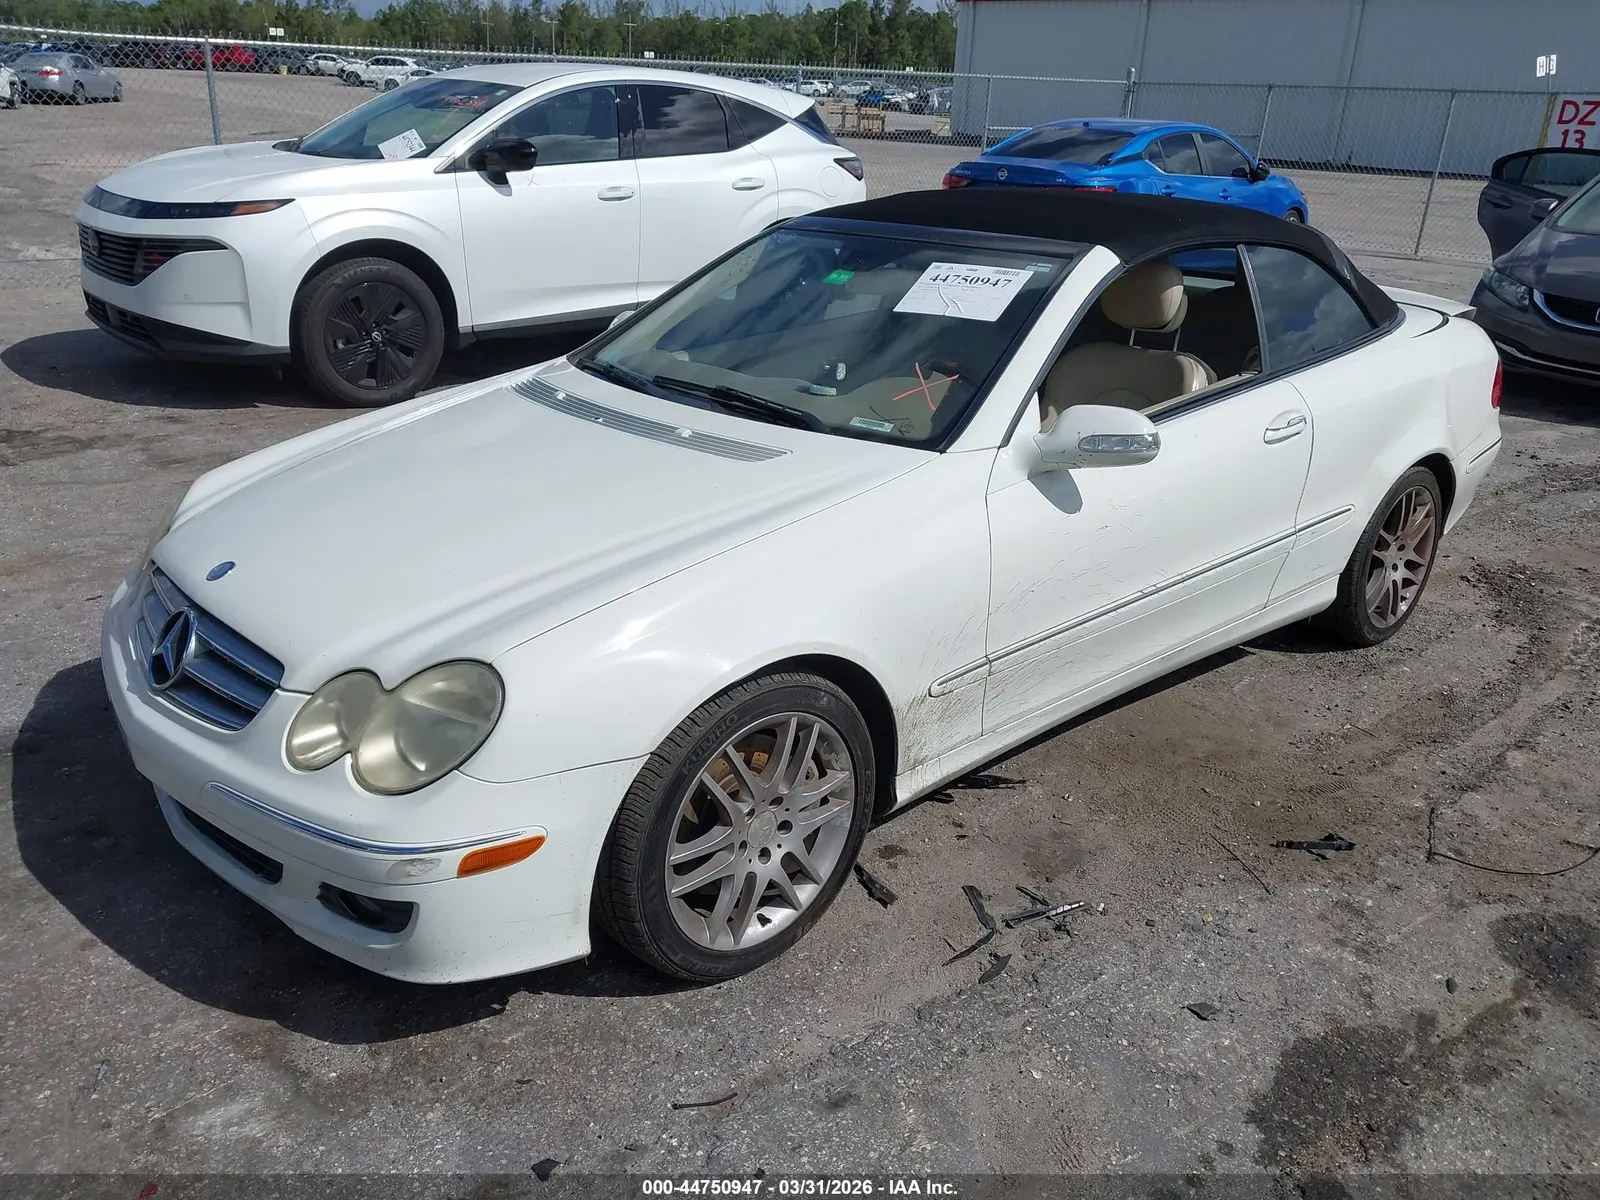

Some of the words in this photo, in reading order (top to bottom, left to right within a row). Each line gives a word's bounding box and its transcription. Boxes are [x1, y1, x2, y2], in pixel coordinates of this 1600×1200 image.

[1557, 99, 1600, 126] DZ
[1561, 129, 1586, 149] 13
[929, 273, 1013, 289] 44750947
[681, 713, 739, 775] KUMHO
